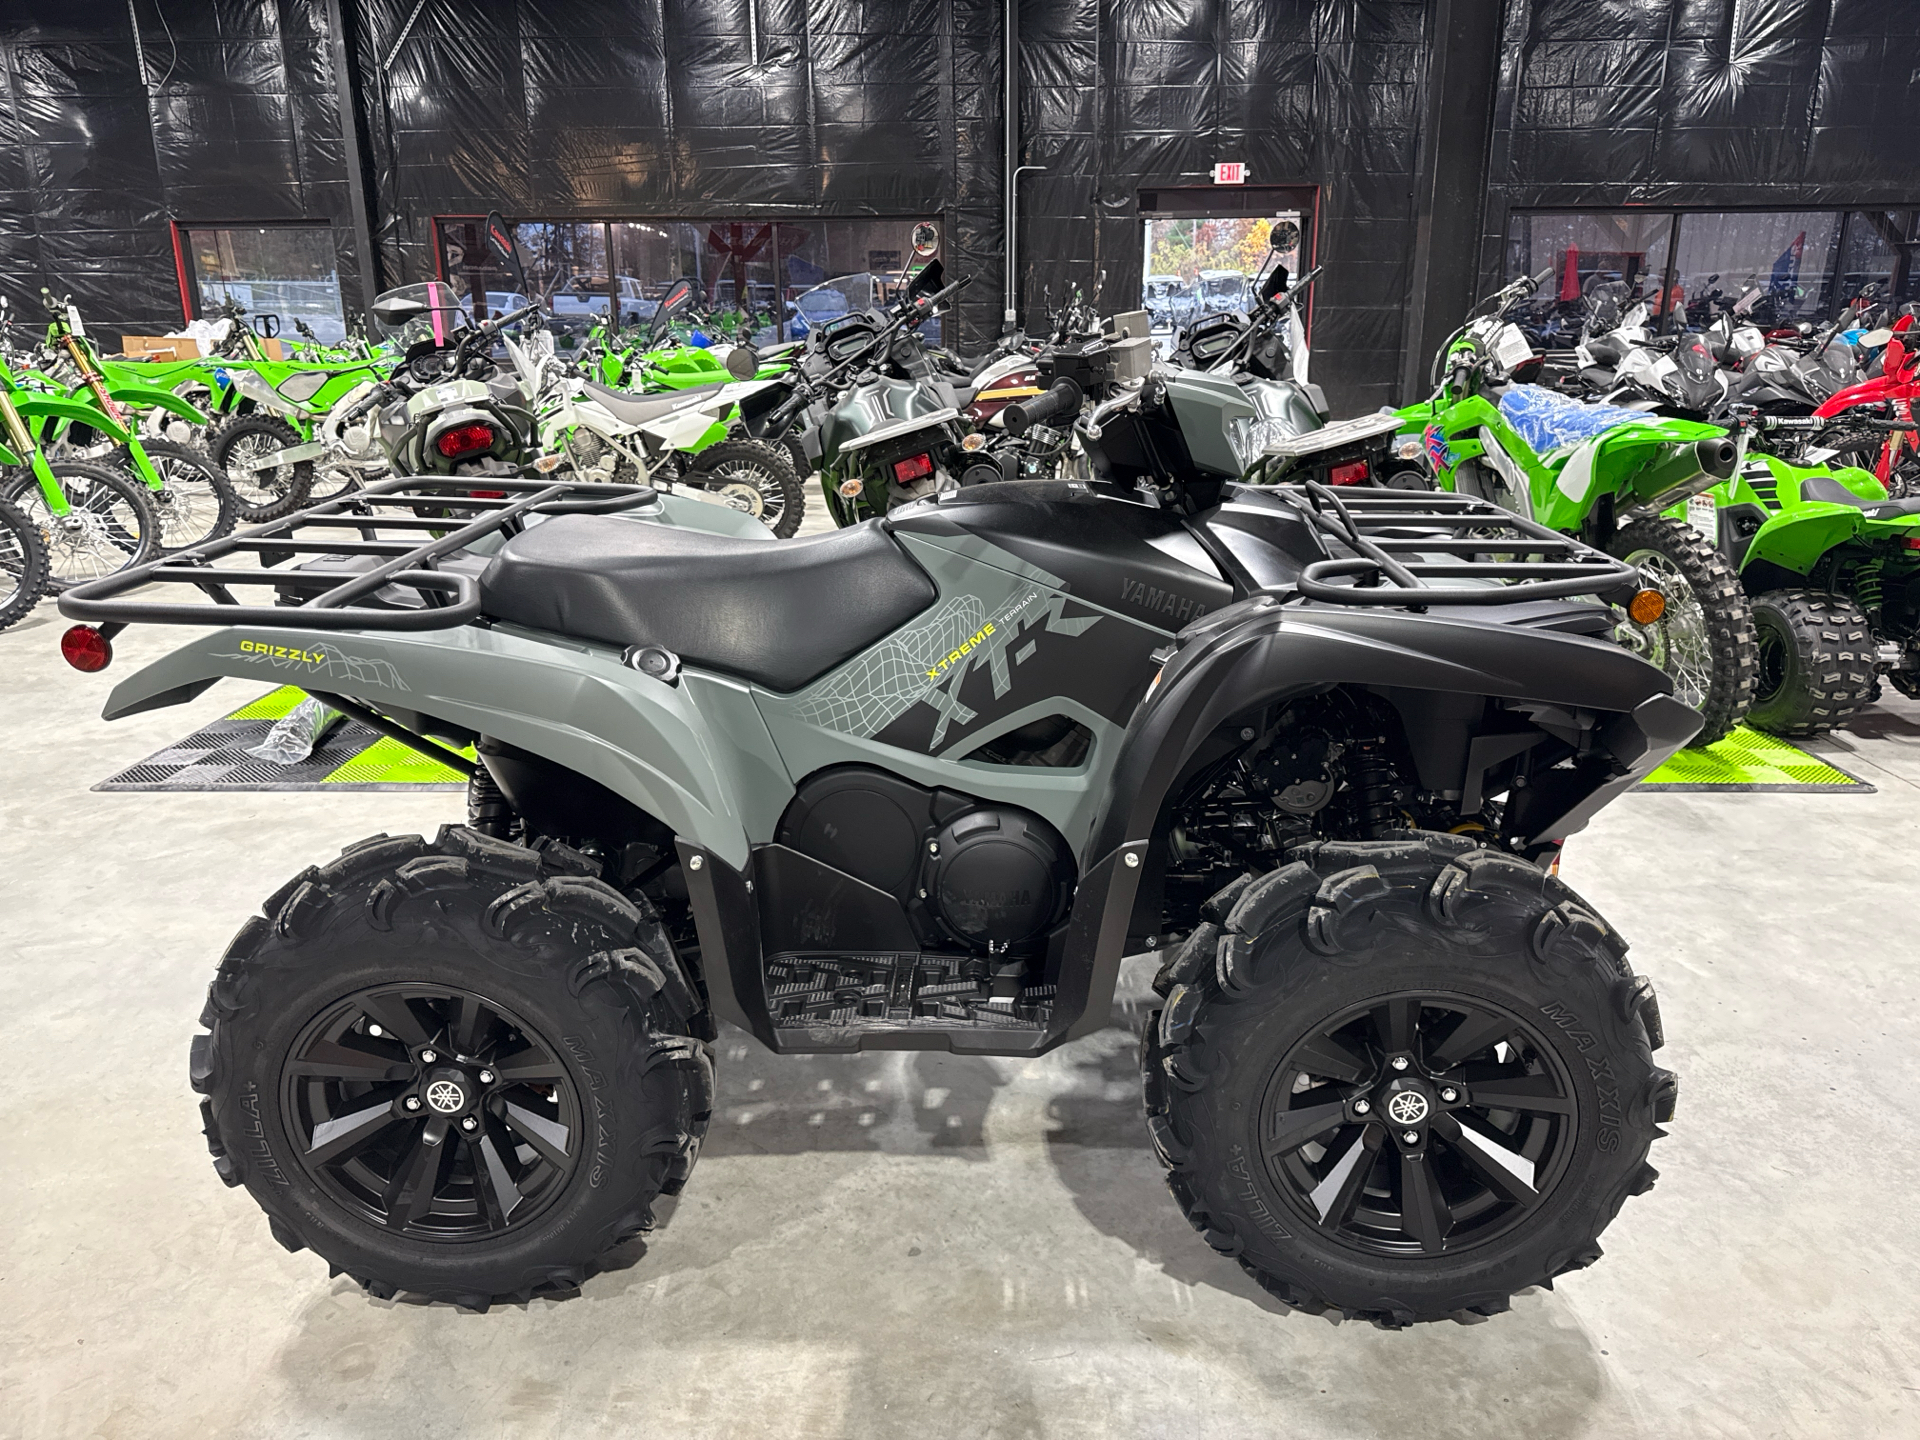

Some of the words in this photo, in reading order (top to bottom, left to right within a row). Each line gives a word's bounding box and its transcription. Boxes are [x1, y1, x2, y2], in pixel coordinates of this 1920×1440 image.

[1220, 164, 1241, 181] EXIT
[1777, 416, 1814, 425] Kawasaki
[1121, 577, 1206, 622] YAMAHA
[240, 640, 326, 664] GRIZZLY
[925, 621, 997, 682] XTREME
[998, 591, 1038, 626] TERRAIN
[1540, 1000, 1621, 1156] MAXXIS
[561, 1035, 618, 1192] MAXXIS
